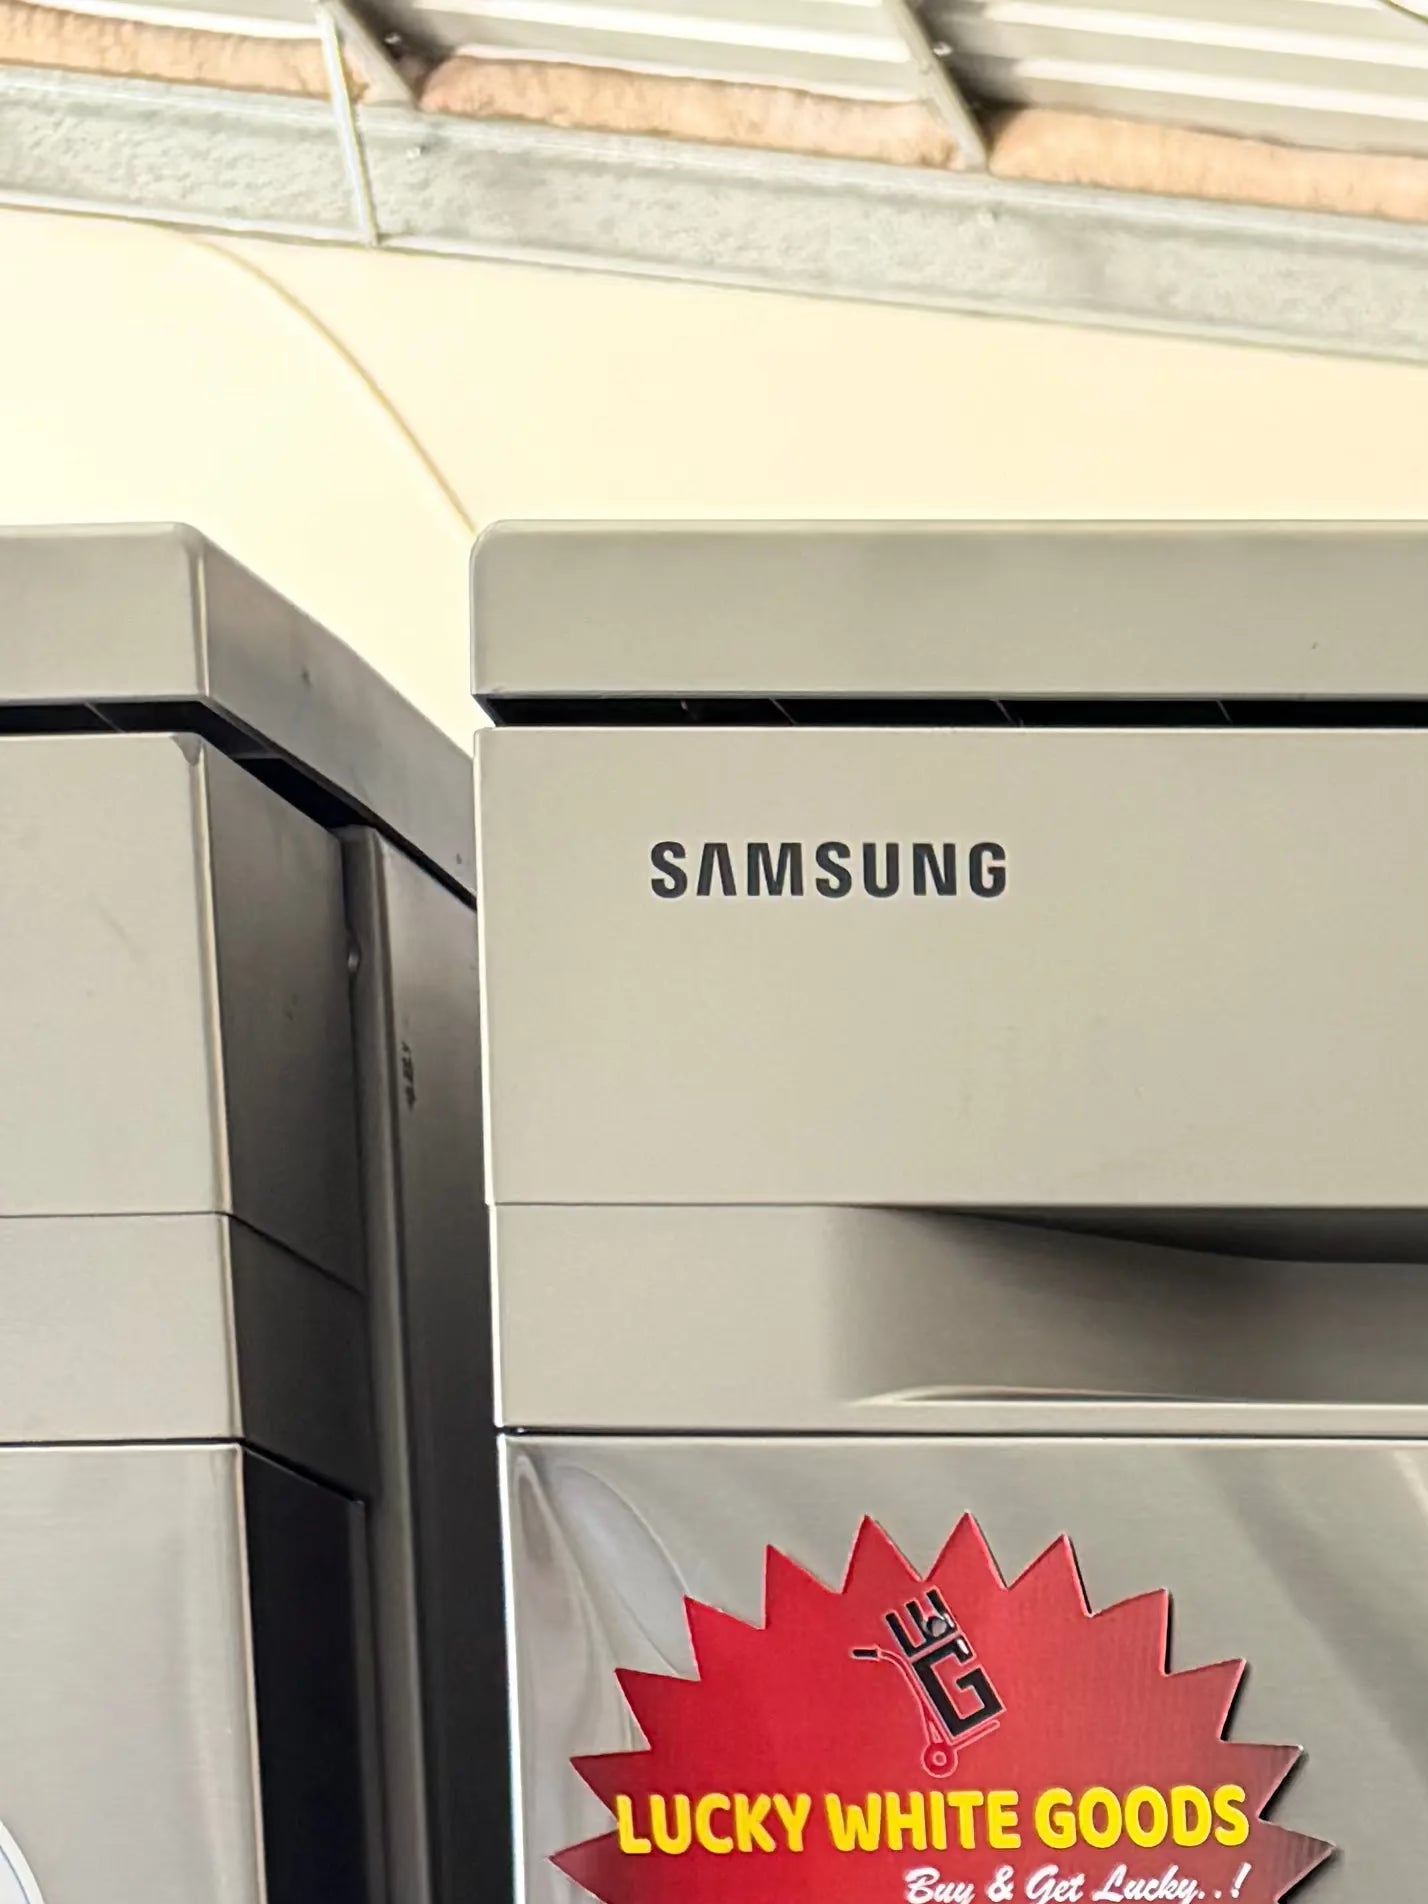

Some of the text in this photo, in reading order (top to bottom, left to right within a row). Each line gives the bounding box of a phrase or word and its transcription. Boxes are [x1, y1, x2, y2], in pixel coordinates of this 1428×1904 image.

[649, 840, 1009, 899] SAMSUNG
[616, 1784, 1250, 1855] LUCKY WHITE GOODS
[986, 1867, 1014, 1903] &
